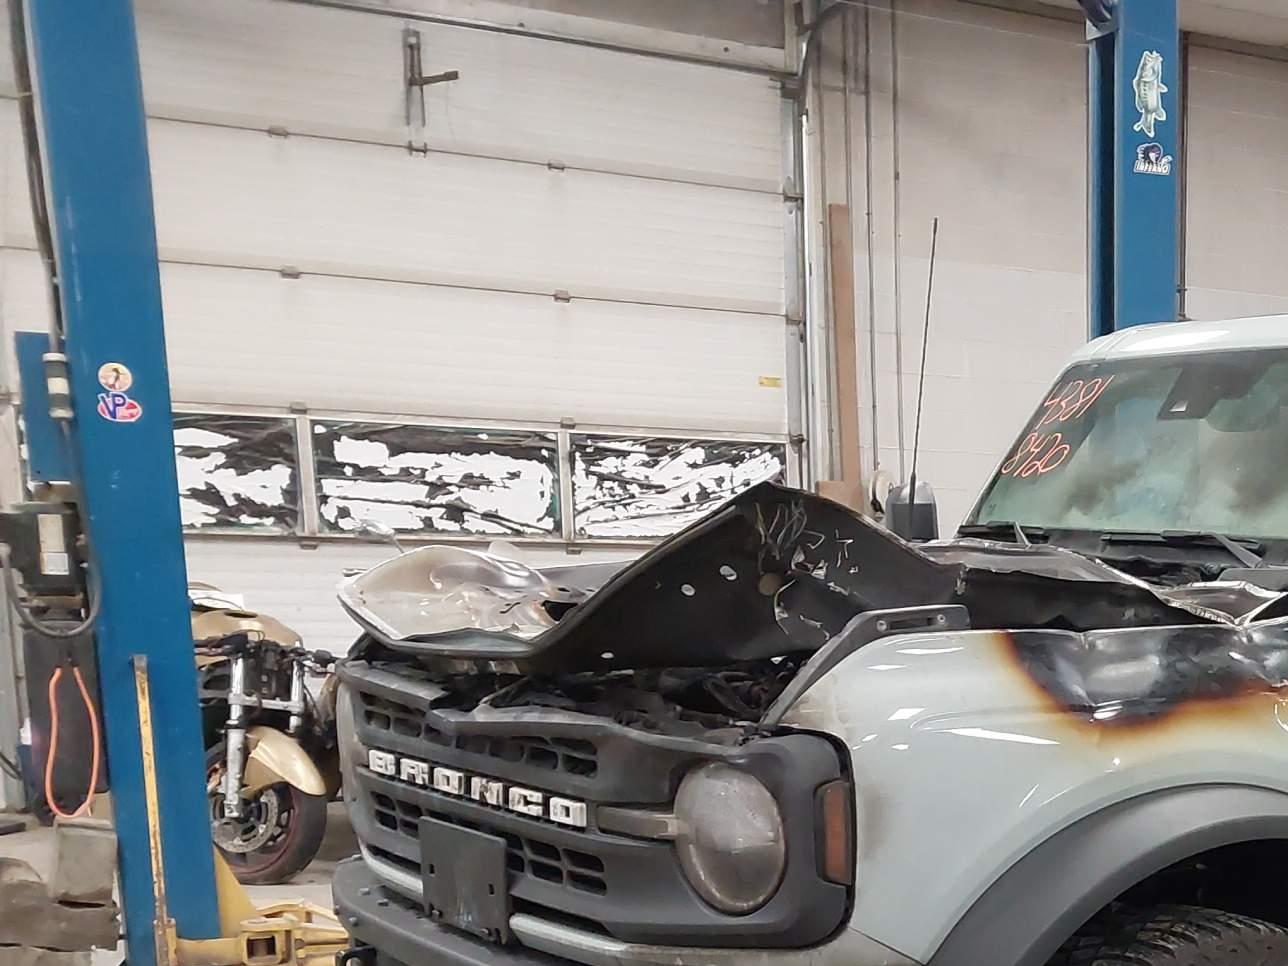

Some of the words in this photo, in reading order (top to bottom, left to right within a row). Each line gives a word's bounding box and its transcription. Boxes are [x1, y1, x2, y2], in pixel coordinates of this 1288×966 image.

[99, 392, 127, 419] VP
[1035, 375, 1116, 430] 4381
[1001, 433, 1071, 478] 8420
[368, 749, 588, 828] BRONCO
